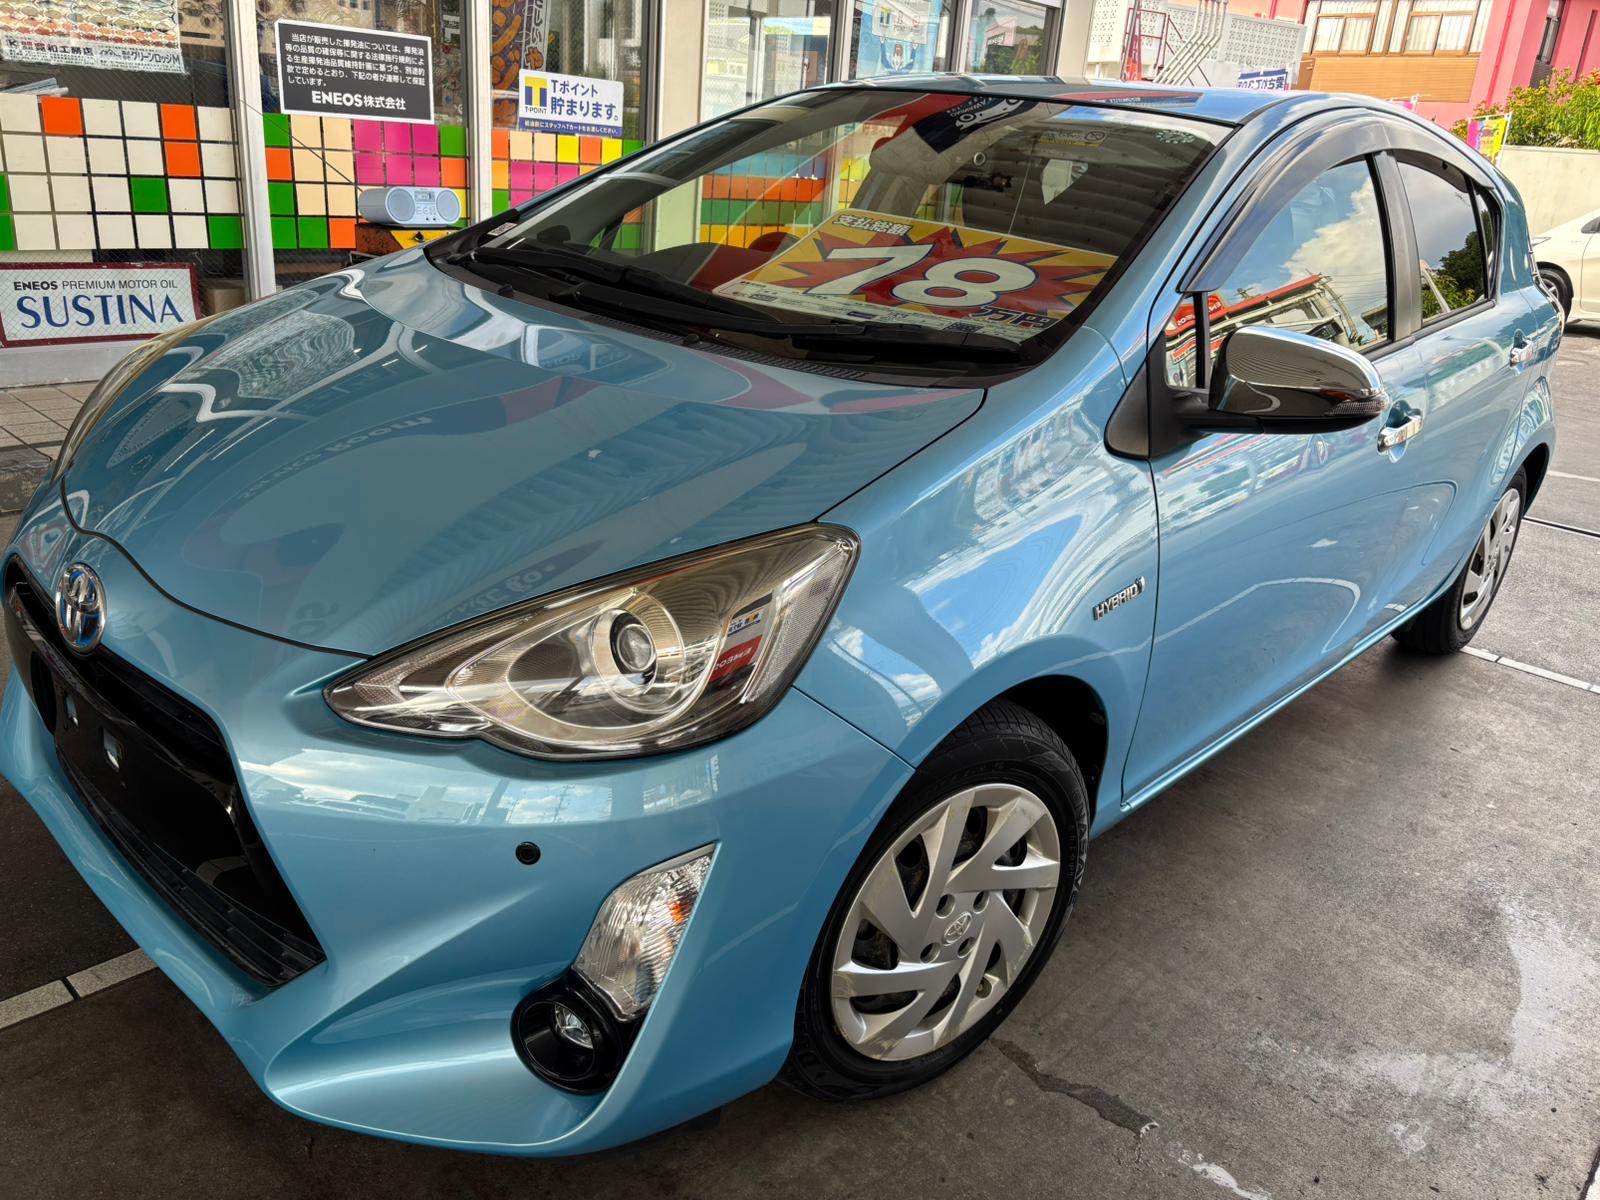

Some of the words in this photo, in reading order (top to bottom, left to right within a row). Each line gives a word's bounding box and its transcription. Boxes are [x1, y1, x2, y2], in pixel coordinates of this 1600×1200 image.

[288, 76, 327, 87] しています。
[551, 79, 598, 98] Tポイント
[311, 90, 407, 111] ENEOS株式会社
[525, 106, 547, 115] T-POINT
[550, 97, 618, 121] 貯まります。
[836, 214, 912, 236] 支払総額
[13, 280, 58, 291] ENEOS
[62, 280, 117, 290] PREMIUM
[118, 280, 158, 290] MOTOR
[160, 279, 178, 289] OIL
[807, 243, 1039, 308] 78
[16, 294, 184, 329] SUSTINA
[968, 305, 1058, 329] 万円
[1093, 583, 1139, 621] HYBRID
